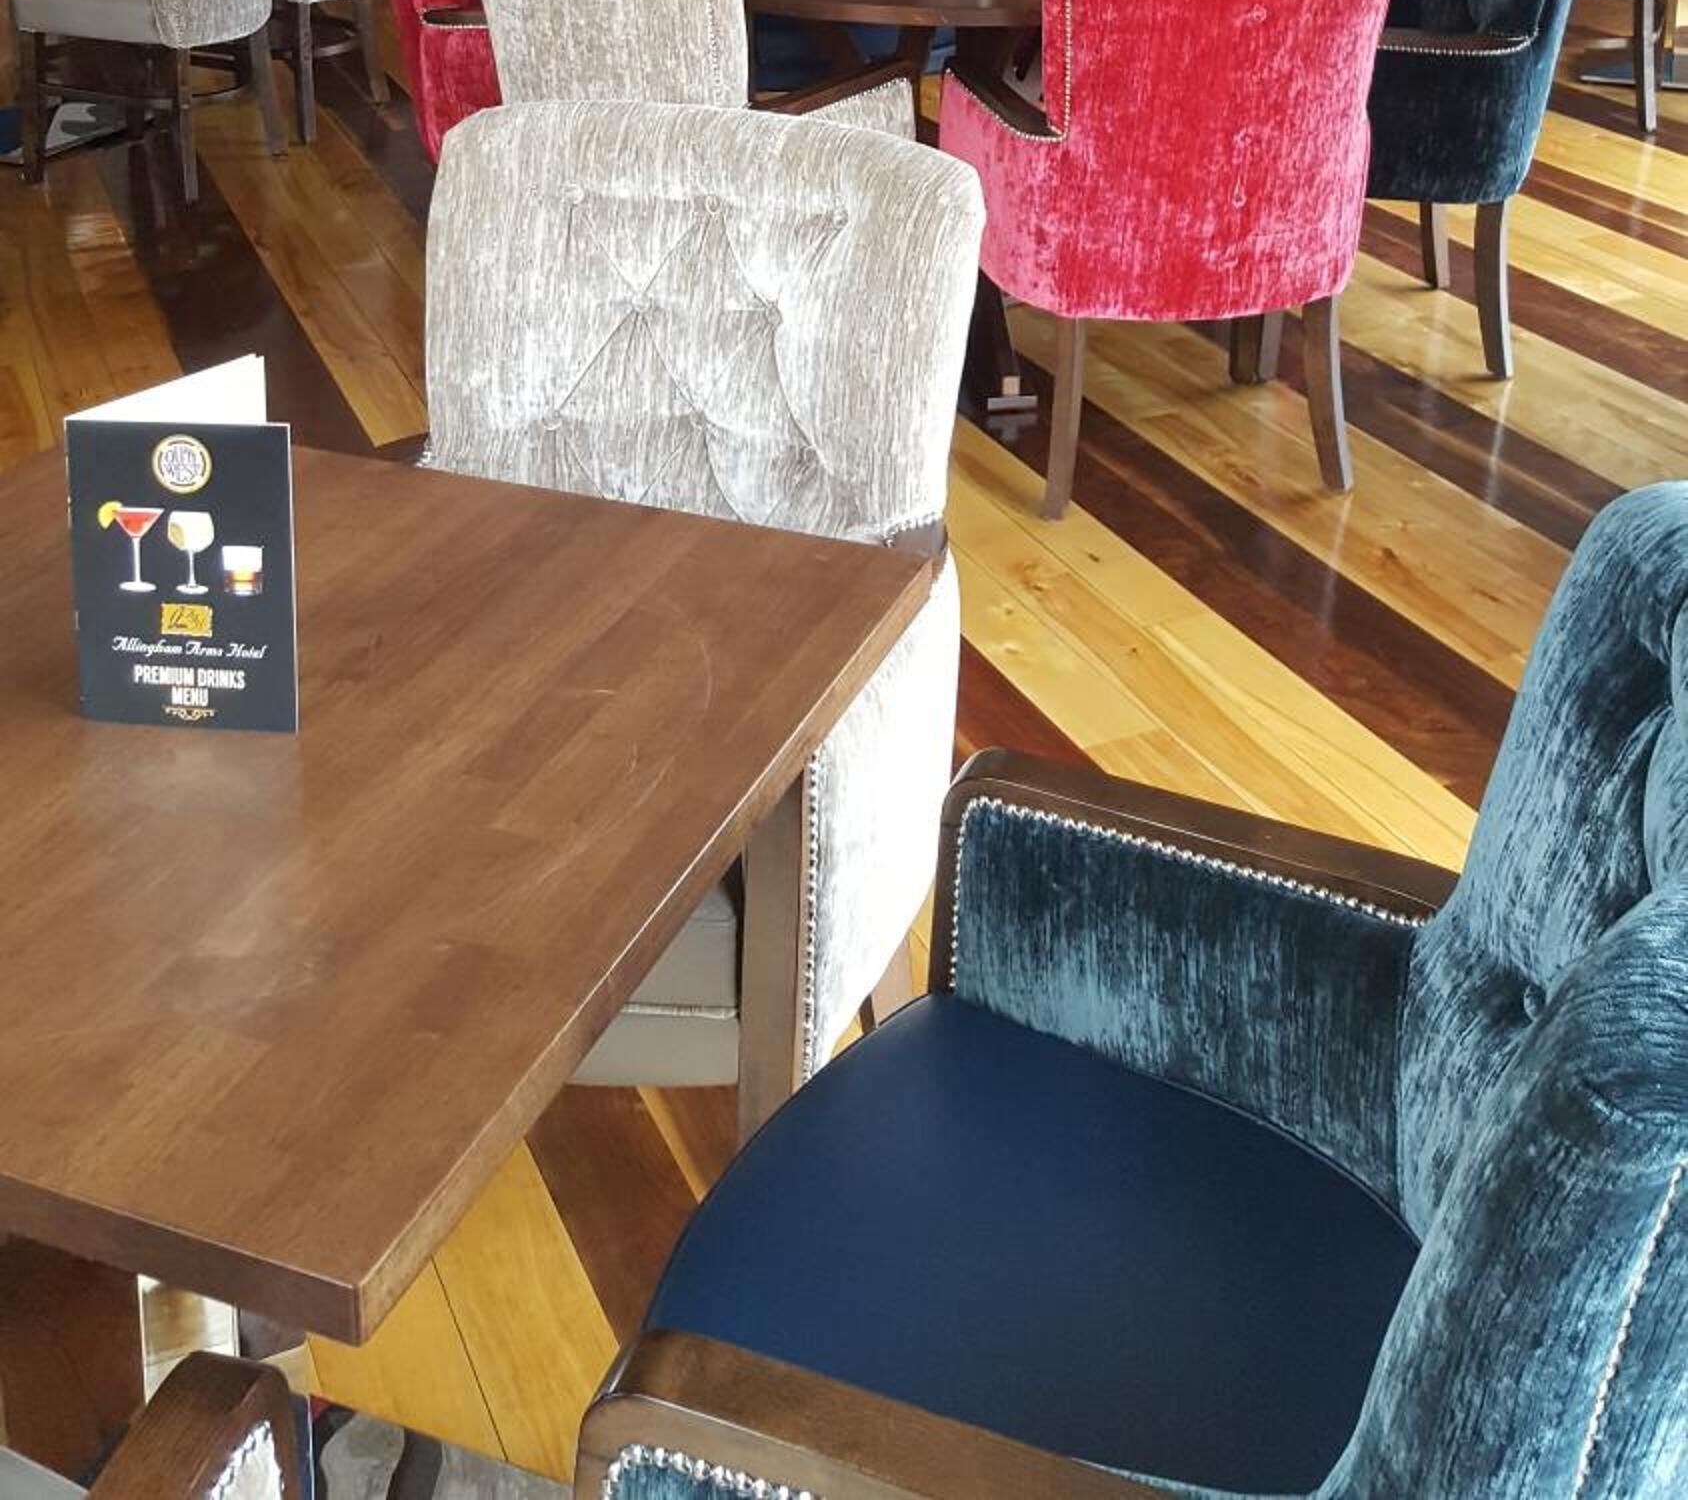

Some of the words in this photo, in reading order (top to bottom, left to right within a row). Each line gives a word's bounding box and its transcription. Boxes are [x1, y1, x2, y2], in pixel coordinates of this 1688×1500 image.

[112, 635, 183, 657] Allingham
[184, 640, 223, 656] Arms
[226, 642, 268, 659] Hotel
[133, 664, 194, 687] PREMIUM
[197, 668, 246, 690] DRINKS
[171, 686, 209, 707] MENU
